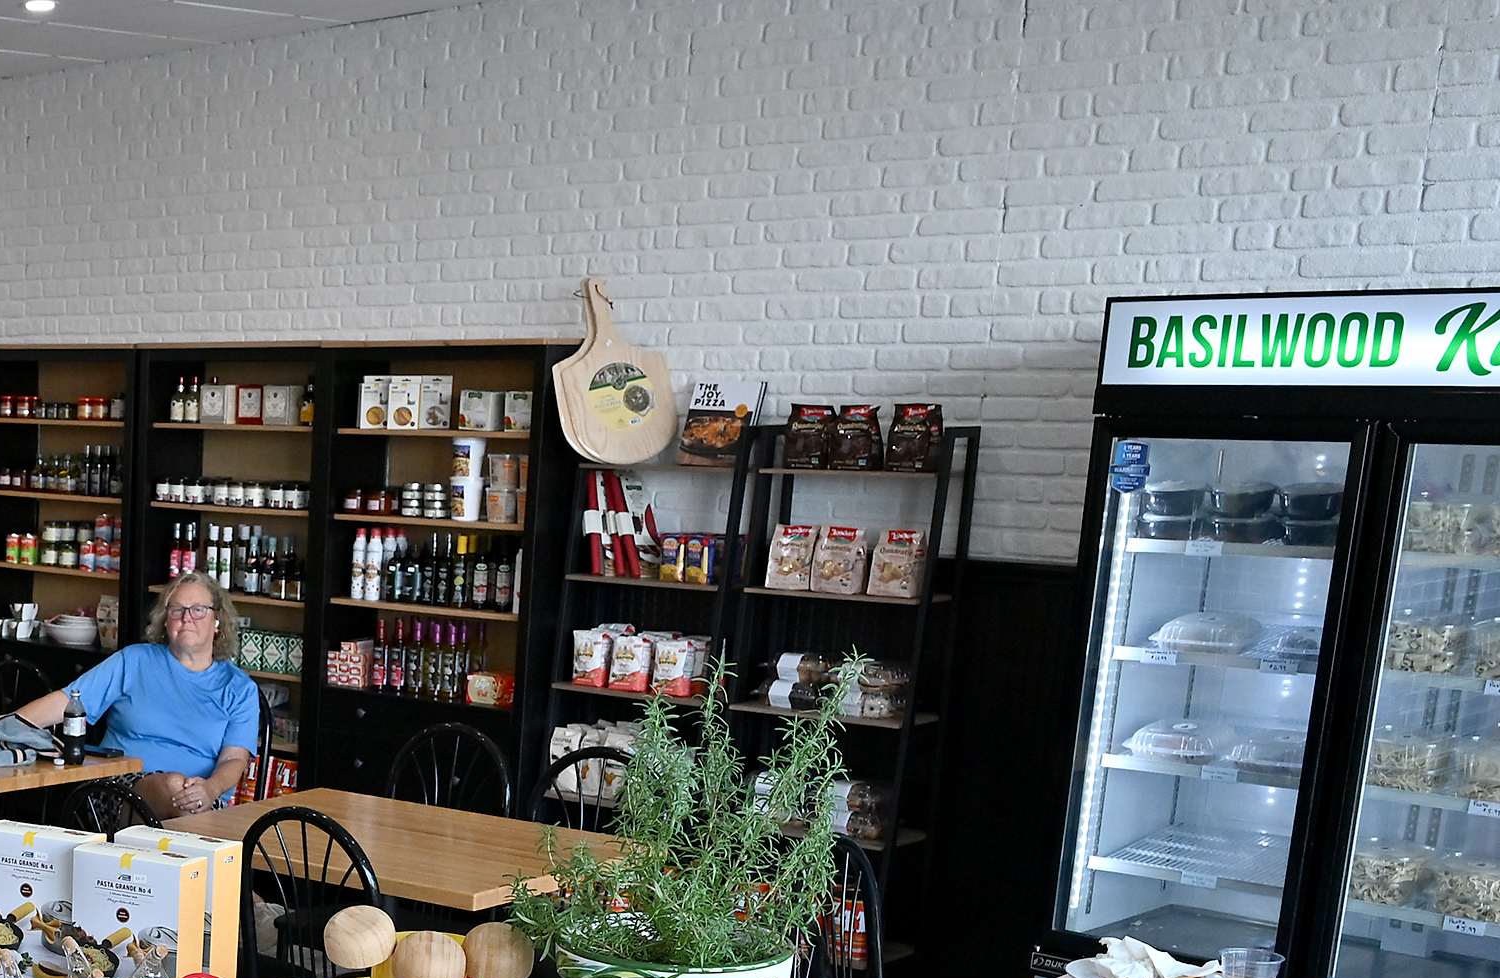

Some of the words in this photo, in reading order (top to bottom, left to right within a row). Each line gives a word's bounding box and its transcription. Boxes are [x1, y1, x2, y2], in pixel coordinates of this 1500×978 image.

[1127, 311, 1405, 368] BASILWOOD
[1434, 302, 1500, 376] K
[699, 383, 719, 391] THE
[701, 391, 722, 399] JOY
[694, 398, 726, 407] PIZZA
[1, 857, 17, 866] PASTA
[19, 859, 39, 869] GRANDE
[97, 880, 114, 888] PASTA
[115, 883, 137, 892] GRANDE
